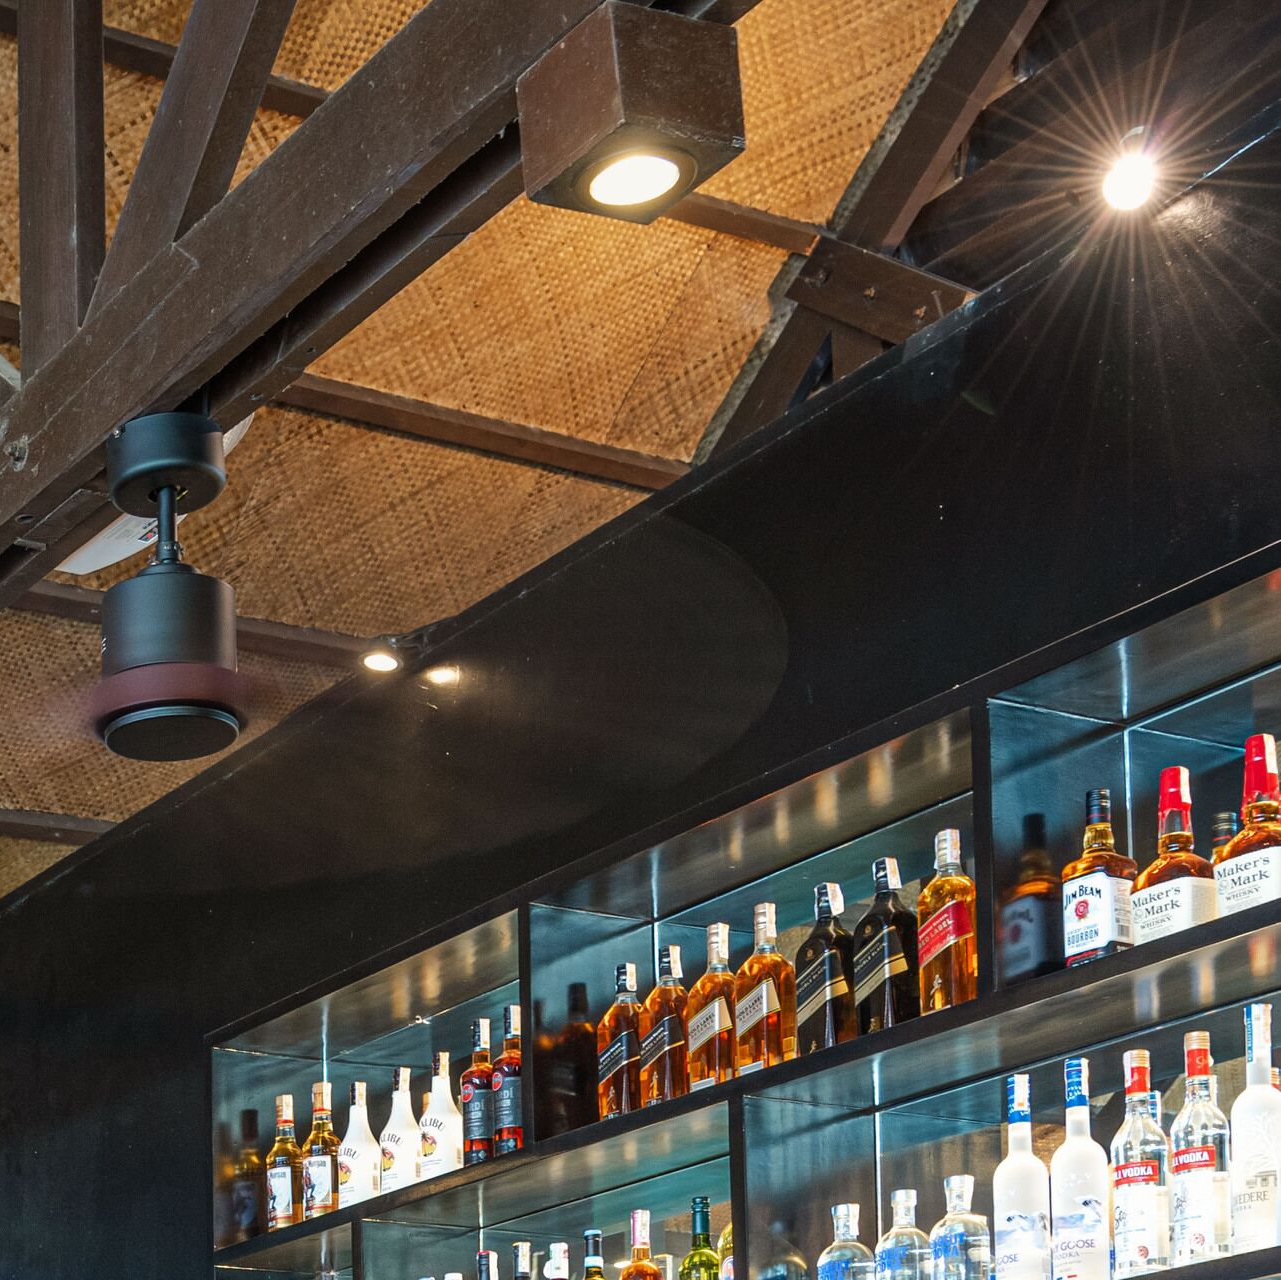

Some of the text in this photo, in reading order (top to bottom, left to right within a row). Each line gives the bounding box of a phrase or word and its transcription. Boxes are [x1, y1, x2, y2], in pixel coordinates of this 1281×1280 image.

[1217, 855, 1270, 881] Maker's
[1230, 869, 1270, 889] Mark
[1078, 884, 1102, 899] BEAM
[1132, 885, 1181, 909] Maker's
[1143, 899, 1181, 919] Mark
[1067, 928, 1099, 946] BOURBON
[1179, 1151, 1210, 1165] VODKA
[1122, 1165, 1154, 1179] VODKA
[1060, 1238, 1096, 1251] GOOSE
